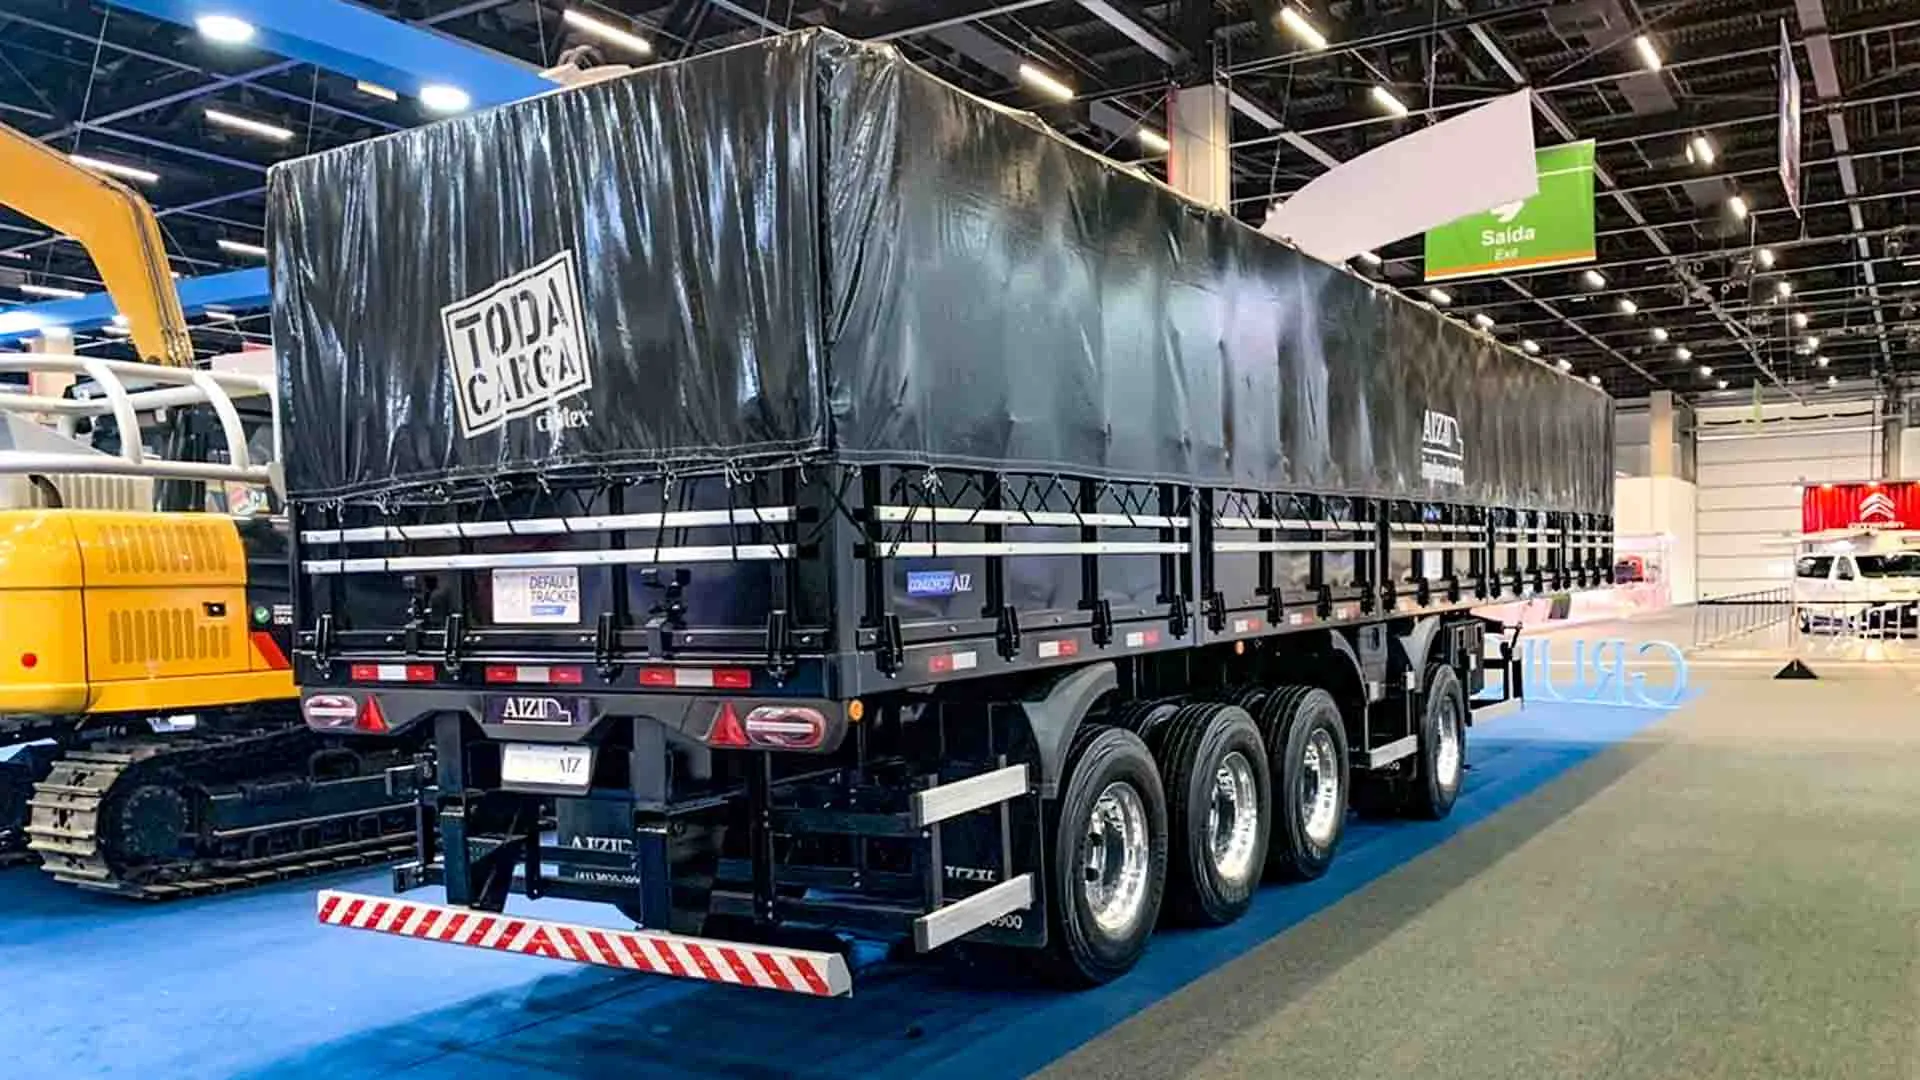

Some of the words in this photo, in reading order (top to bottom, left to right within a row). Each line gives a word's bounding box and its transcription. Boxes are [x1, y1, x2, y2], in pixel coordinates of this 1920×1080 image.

[1481, 225, 1537, 247] Saída
[1494, 248, 1519, 261] Exit
[455, 277, 569, 369] TODA
[468, 337, 577, 416] CARGA
[529, 576, 575, 589] DEFAULT
[531, 590, 577, 602] TRACKER
